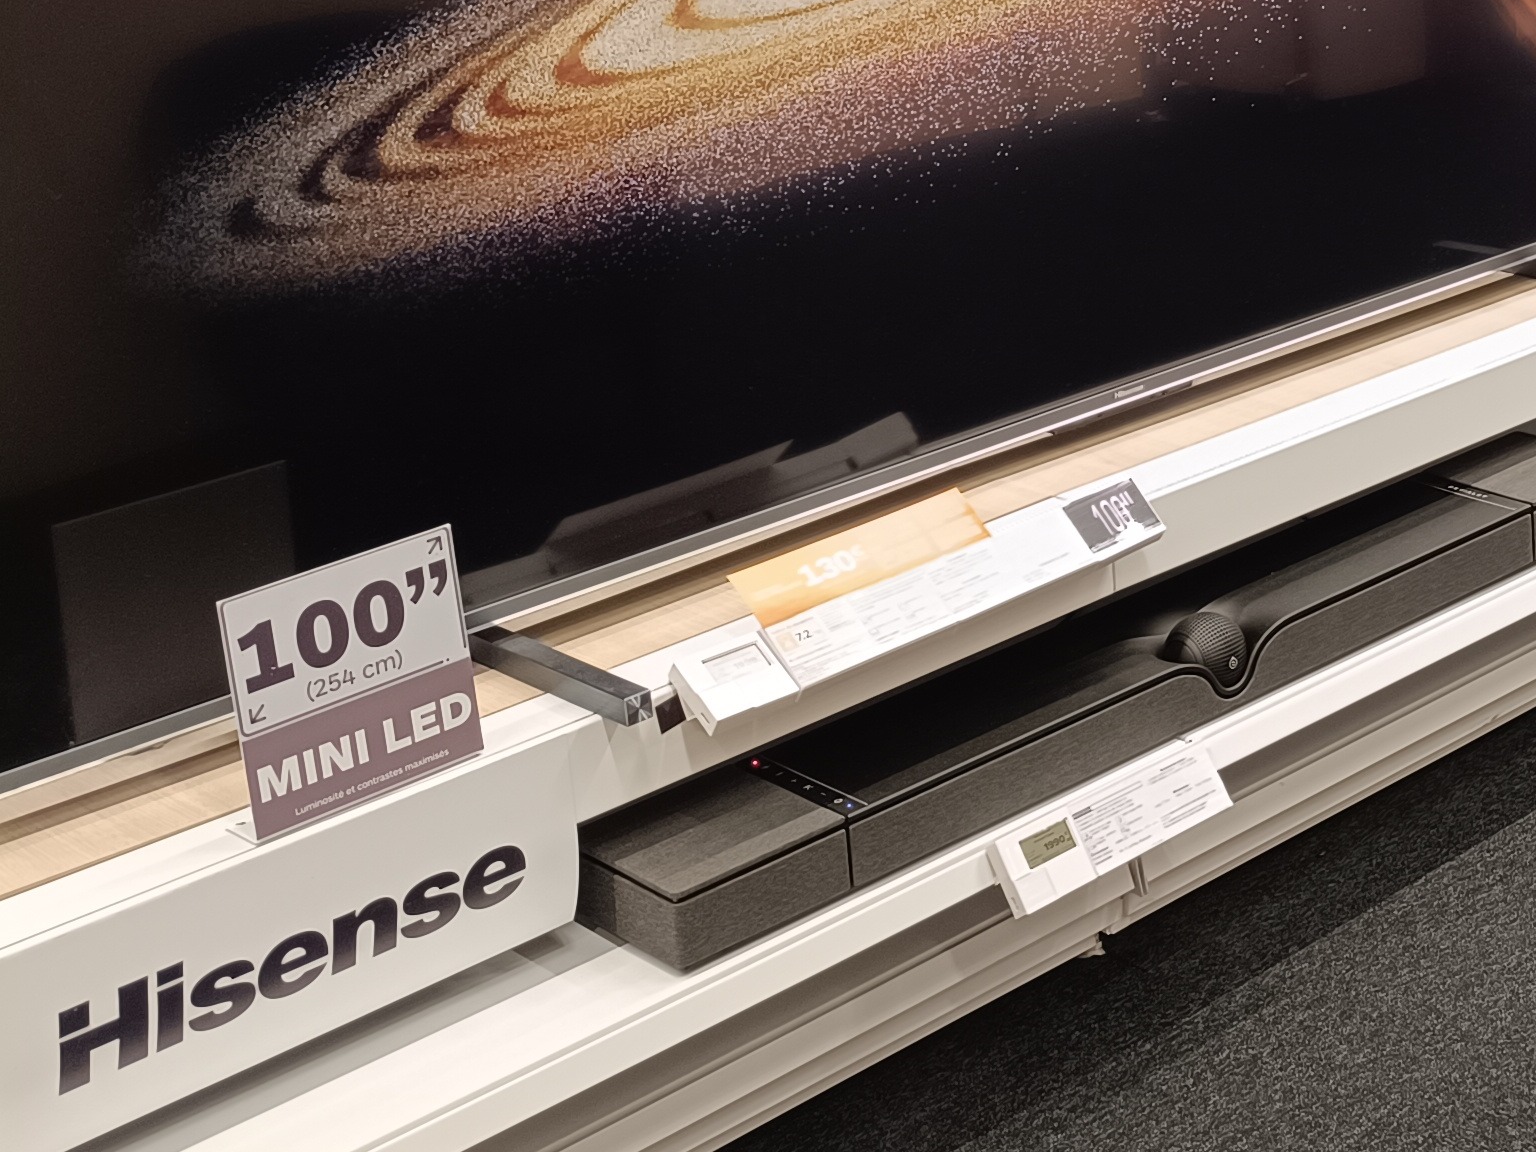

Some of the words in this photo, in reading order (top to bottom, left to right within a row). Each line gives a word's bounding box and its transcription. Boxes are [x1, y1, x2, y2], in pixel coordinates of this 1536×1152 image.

[306, 667, 357, 703] (254
[360, 648, 405, 684] cm)
[257, 728, 370, 803] MINI
[384, 692, 472, 753] LED
[294, 789, 345, 816] Luminosité
[346, 785, 356, 796] et
[357, 766, 404, 791] contrastes
[404, 748, 450, 772] maximisés
[58, 844, 527, 1096] Hisense
